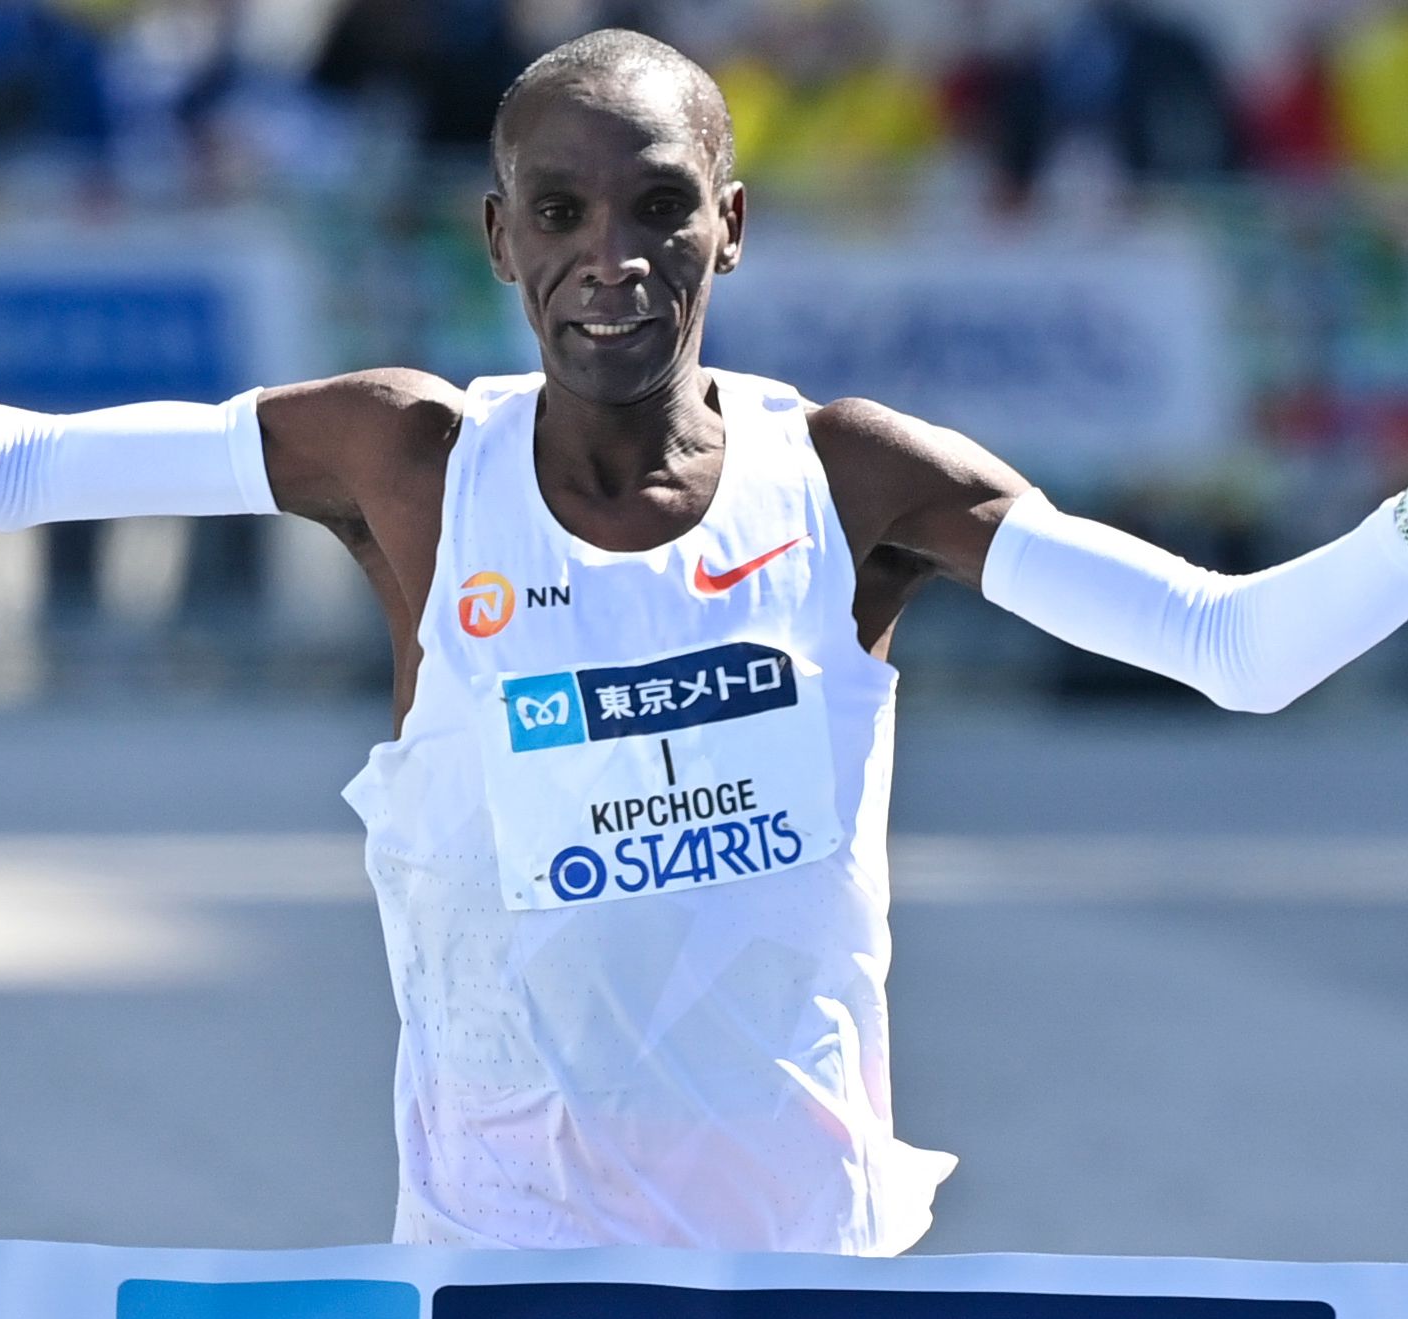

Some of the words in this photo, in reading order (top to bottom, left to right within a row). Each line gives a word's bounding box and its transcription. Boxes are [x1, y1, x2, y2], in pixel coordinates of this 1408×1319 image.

[526, 585, 571, 608] NN
[595, 656, 782, 722] 東京メトロ
[591, 779, 758, 835] KIPCHOGE
